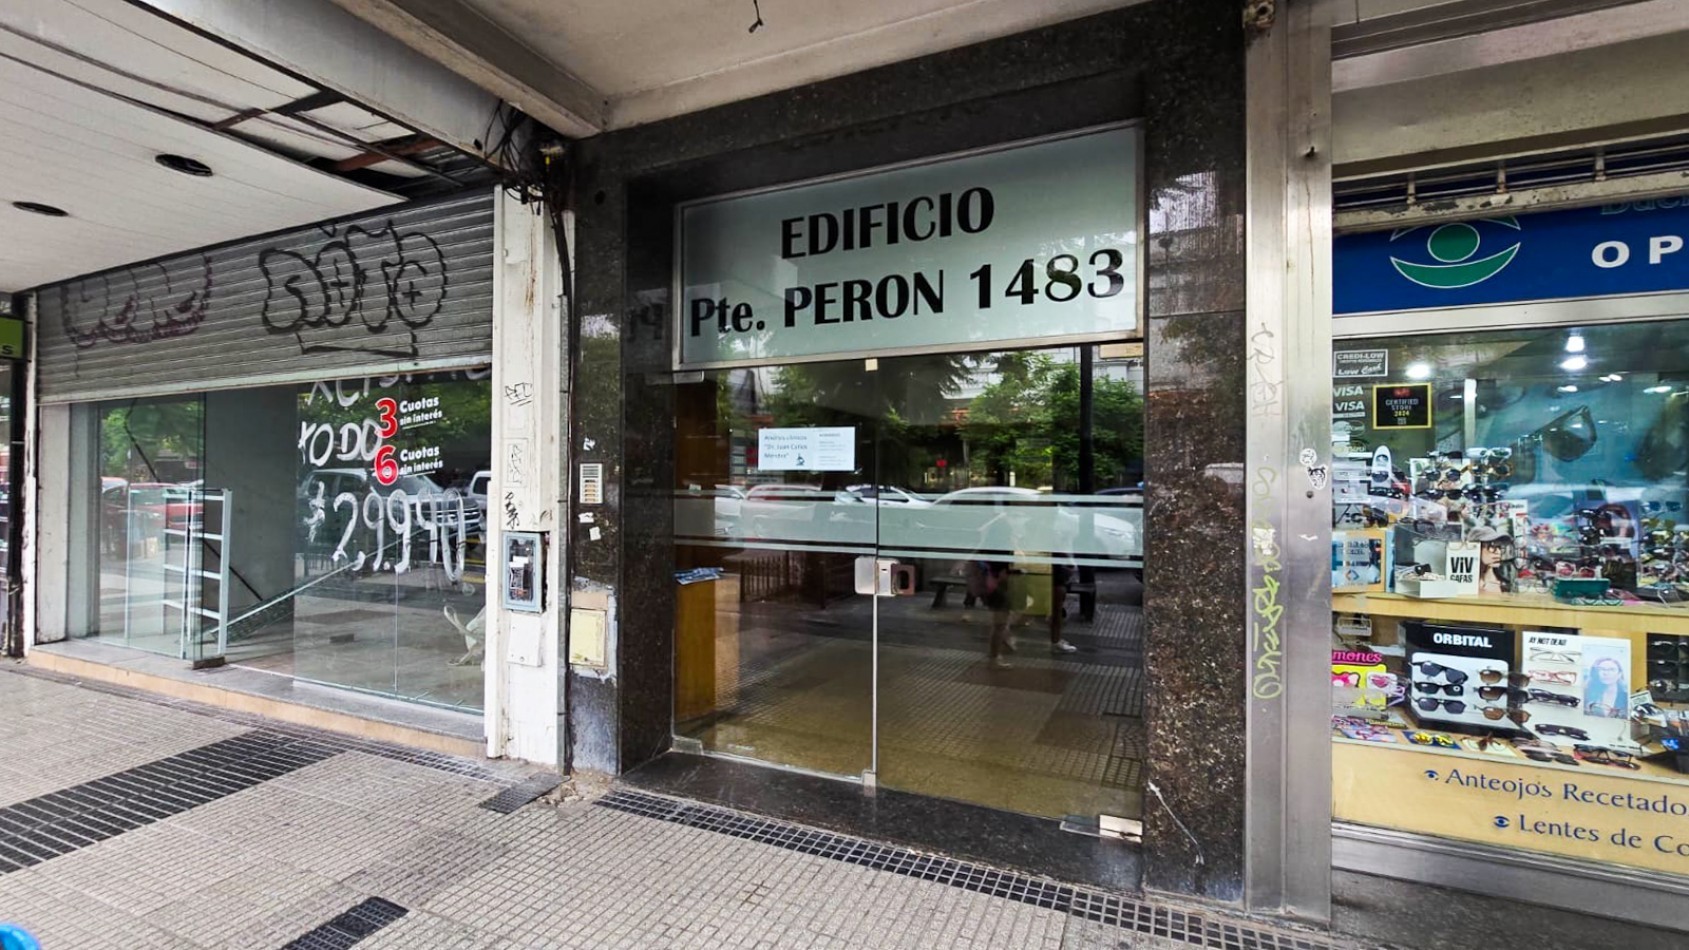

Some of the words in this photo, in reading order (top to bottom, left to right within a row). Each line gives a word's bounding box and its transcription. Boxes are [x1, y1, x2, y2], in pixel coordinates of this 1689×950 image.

[782, 187, 995, 259] EDIFICIO
[691, 297, 766, 337] Pte.
[784, 269, 944, 327] PERON
[970, 248, 1125, 308] 1483
[1332, 386, 1364, 397] VISA
[1334, 400, 1365, 411] VISA
[374, 397, 399, 439] 3
[399, 395, 440, 414] Cuotas
[399, 415, 412, 426] sin
[412, 408, 444, 423] interés
[374, 444, 399, 486] 6
[399, 445, 440, 461] Cuotas
[412, 458, 445, 473] interés
[1433, 632, 1493, 648] ORBITAL
[1445, 768, 1552, 799] Anteojos
[1562, 783, 1689, 817] Recetado
[1519, 814, 1599, 842] Lentes
[1610, 828, 1642, 849] de
